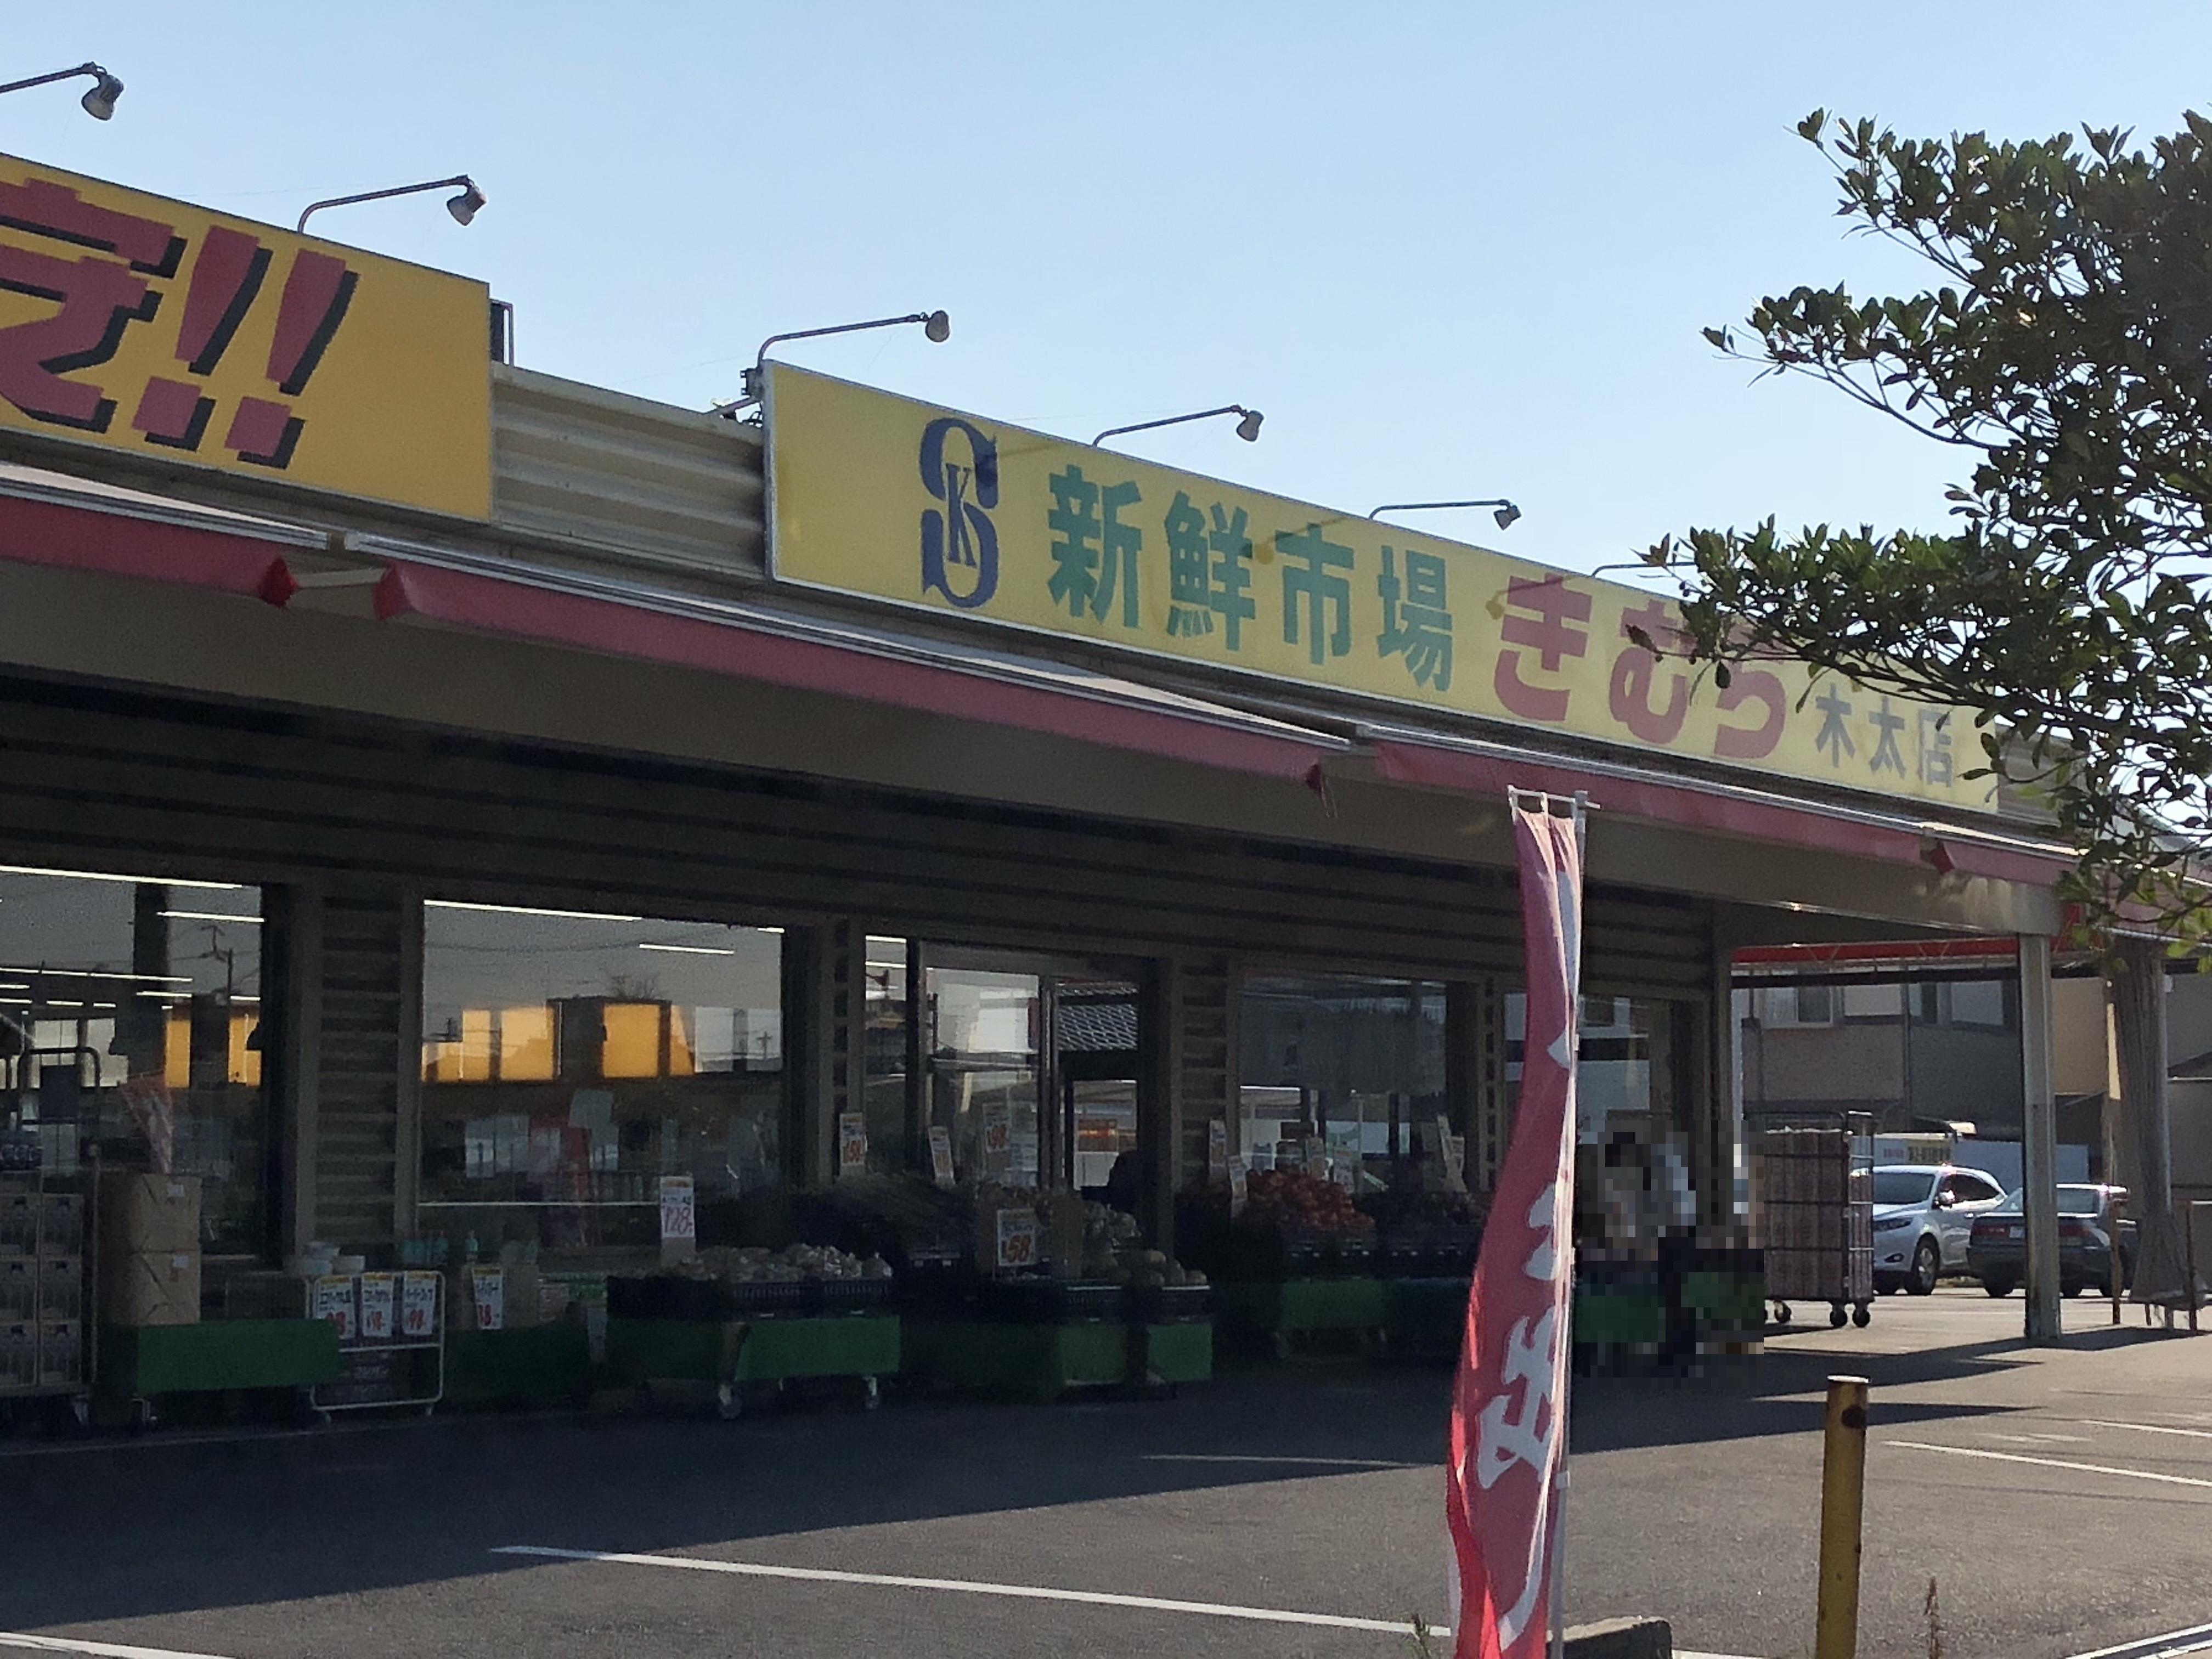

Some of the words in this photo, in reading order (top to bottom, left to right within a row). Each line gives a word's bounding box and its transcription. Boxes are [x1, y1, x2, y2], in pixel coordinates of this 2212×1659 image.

[1047, 465, 1453, 692] 新鮮市場
[1494, 573, 1786, 759] きむら
[1814, 682, 1953, 788] 木太店
